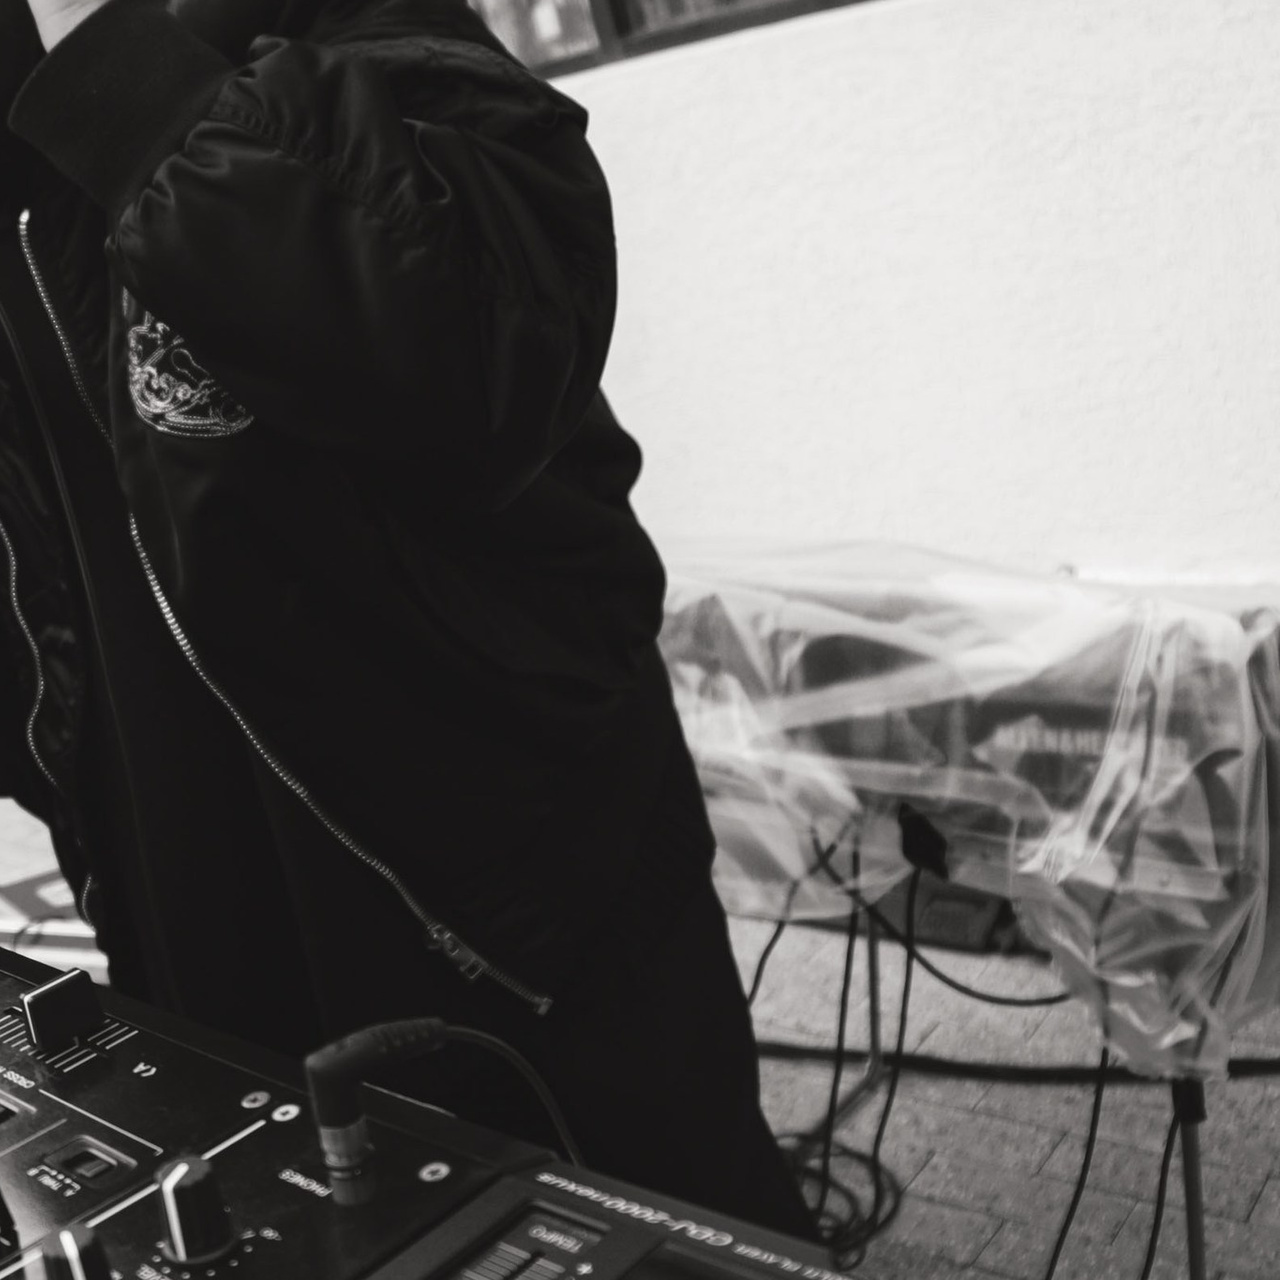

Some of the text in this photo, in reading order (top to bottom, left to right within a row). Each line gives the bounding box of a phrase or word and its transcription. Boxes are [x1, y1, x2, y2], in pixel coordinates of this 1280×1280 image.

[2, 1067, 36, 1089] CROSS
[278, 1168, 333, 1198] PHONES
[528, 1224, 582, 1254] TEMPO
